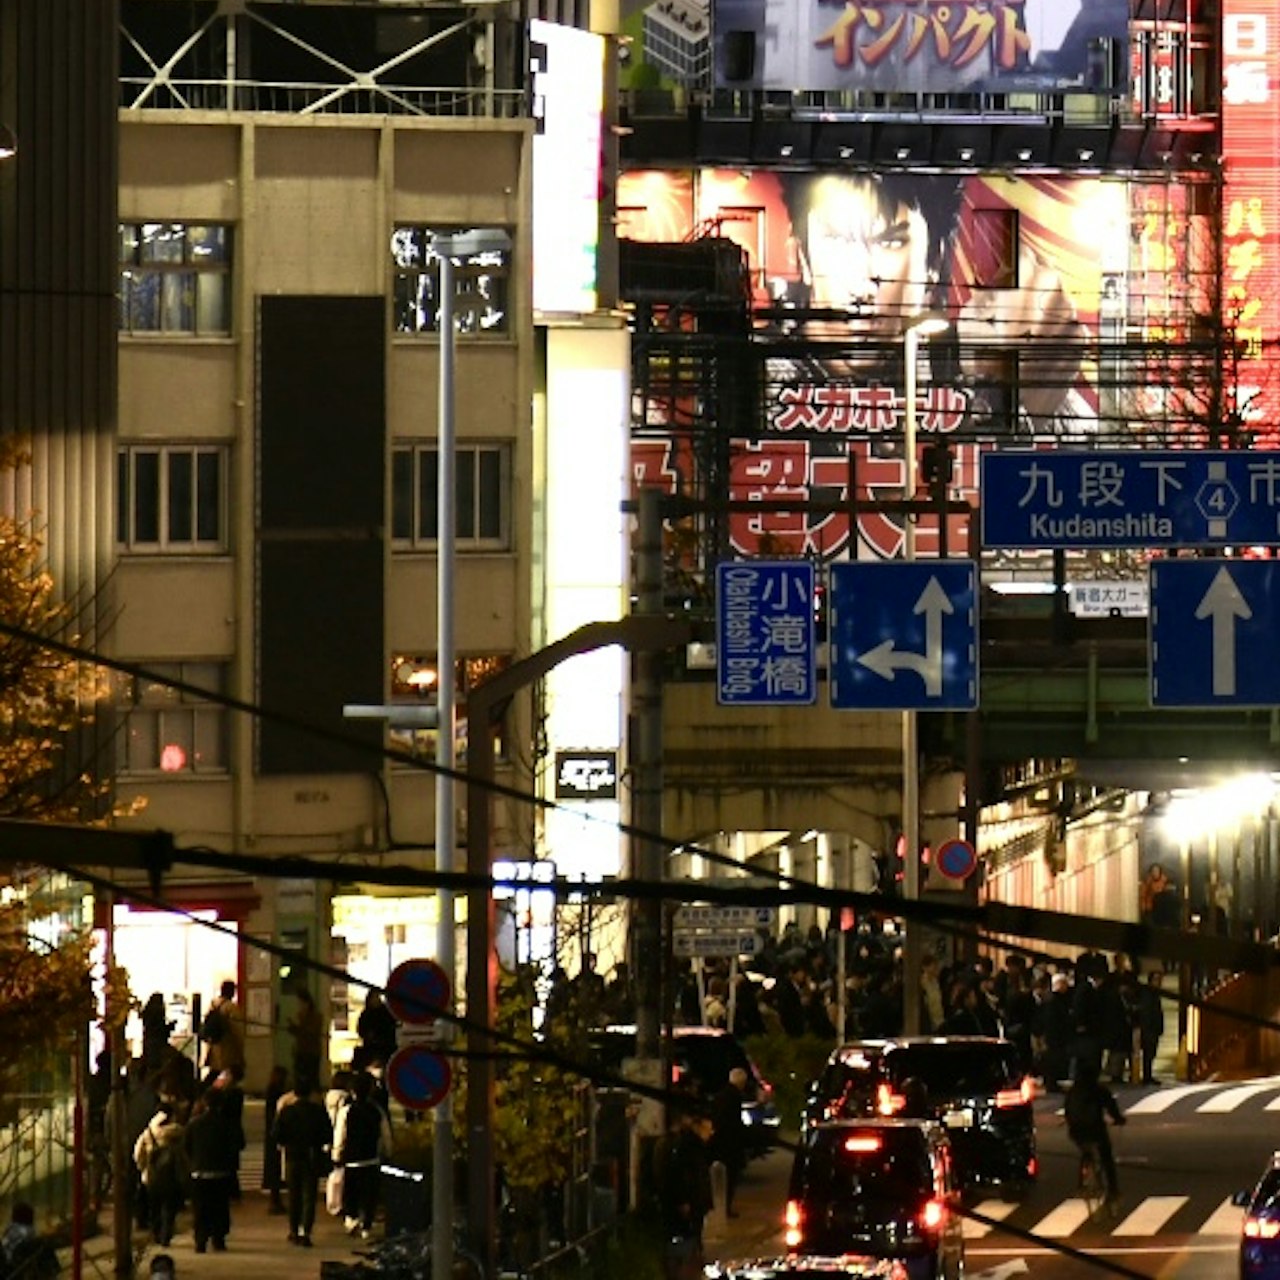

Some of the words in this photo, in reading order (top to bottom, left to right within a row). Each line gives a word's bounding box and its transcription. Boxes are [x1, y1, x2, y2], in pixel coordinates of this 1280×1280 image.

[814, 1, 1032, 70] インパクト
[774, 384, 967, 433] メガホール
[1018, 460, 1187, 508] 九段下
[1206, 486, 1228, 509] 4
[1030, 513, 1173, 539] Kudanshita
[726, 569, 757, 651] Otakibashi
[760, 570, 807, 696] 小滝橋
